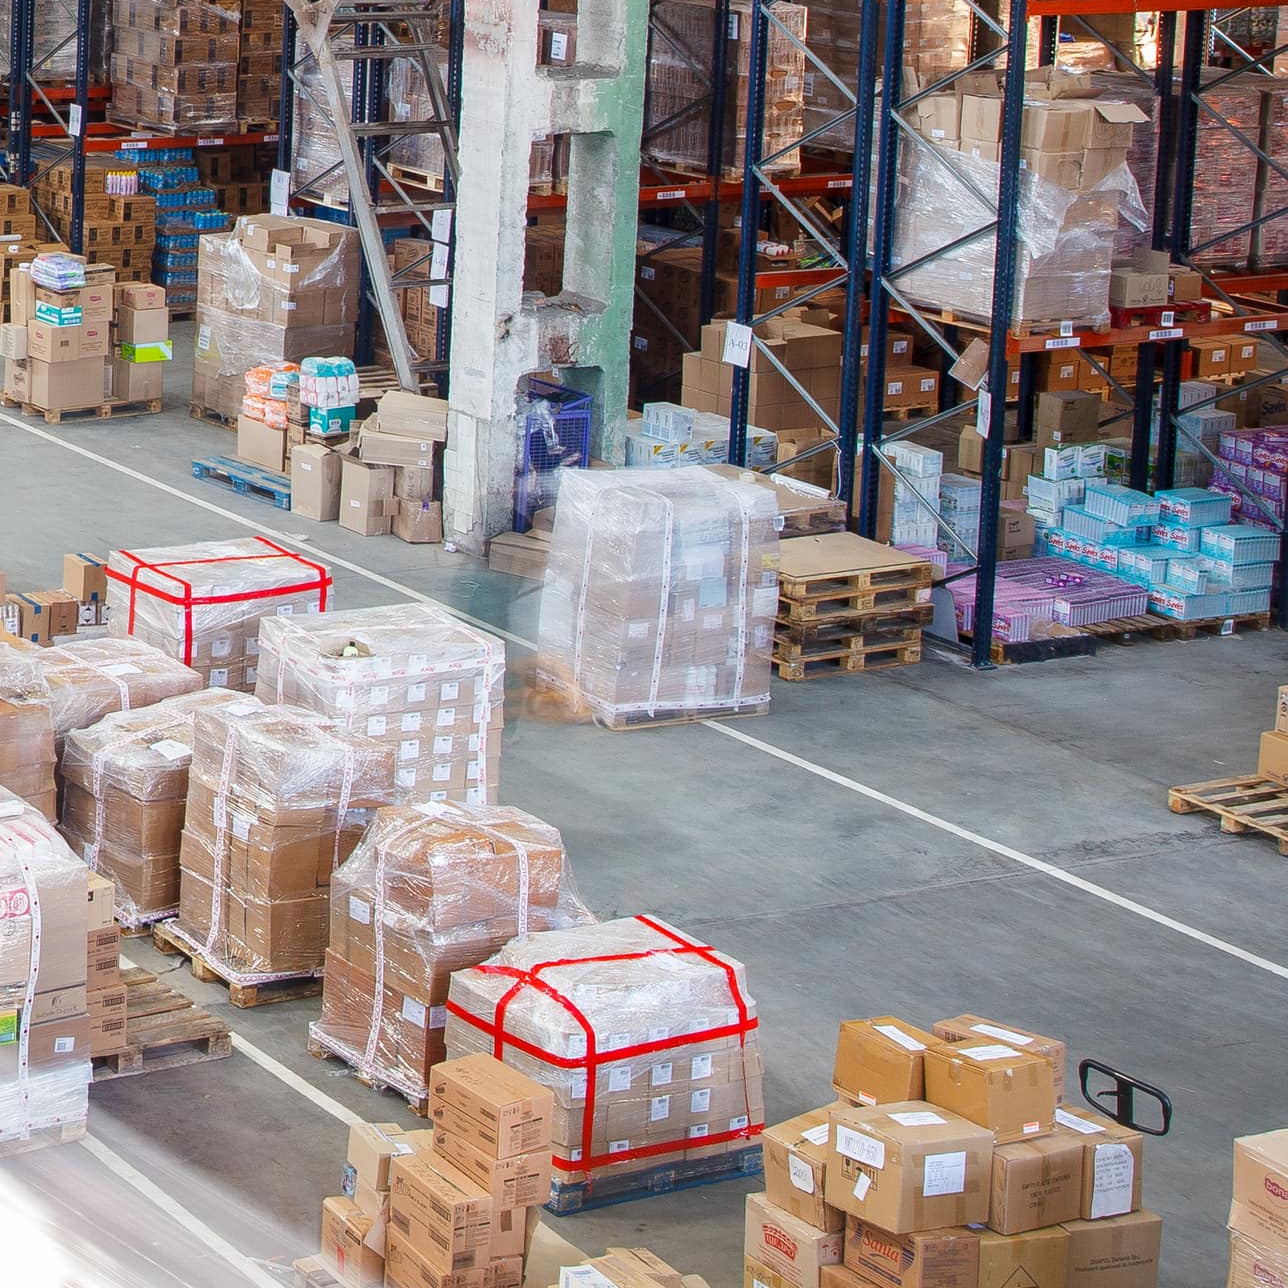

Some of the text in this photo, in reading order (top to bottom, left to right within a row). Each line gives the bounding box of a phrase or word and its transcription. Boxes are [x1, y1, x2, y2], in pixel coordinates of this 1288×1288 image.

[1048, 534, 1116, 563] Savex Savex Savex Savex
[1167, 599, 1184, 610] Savex
